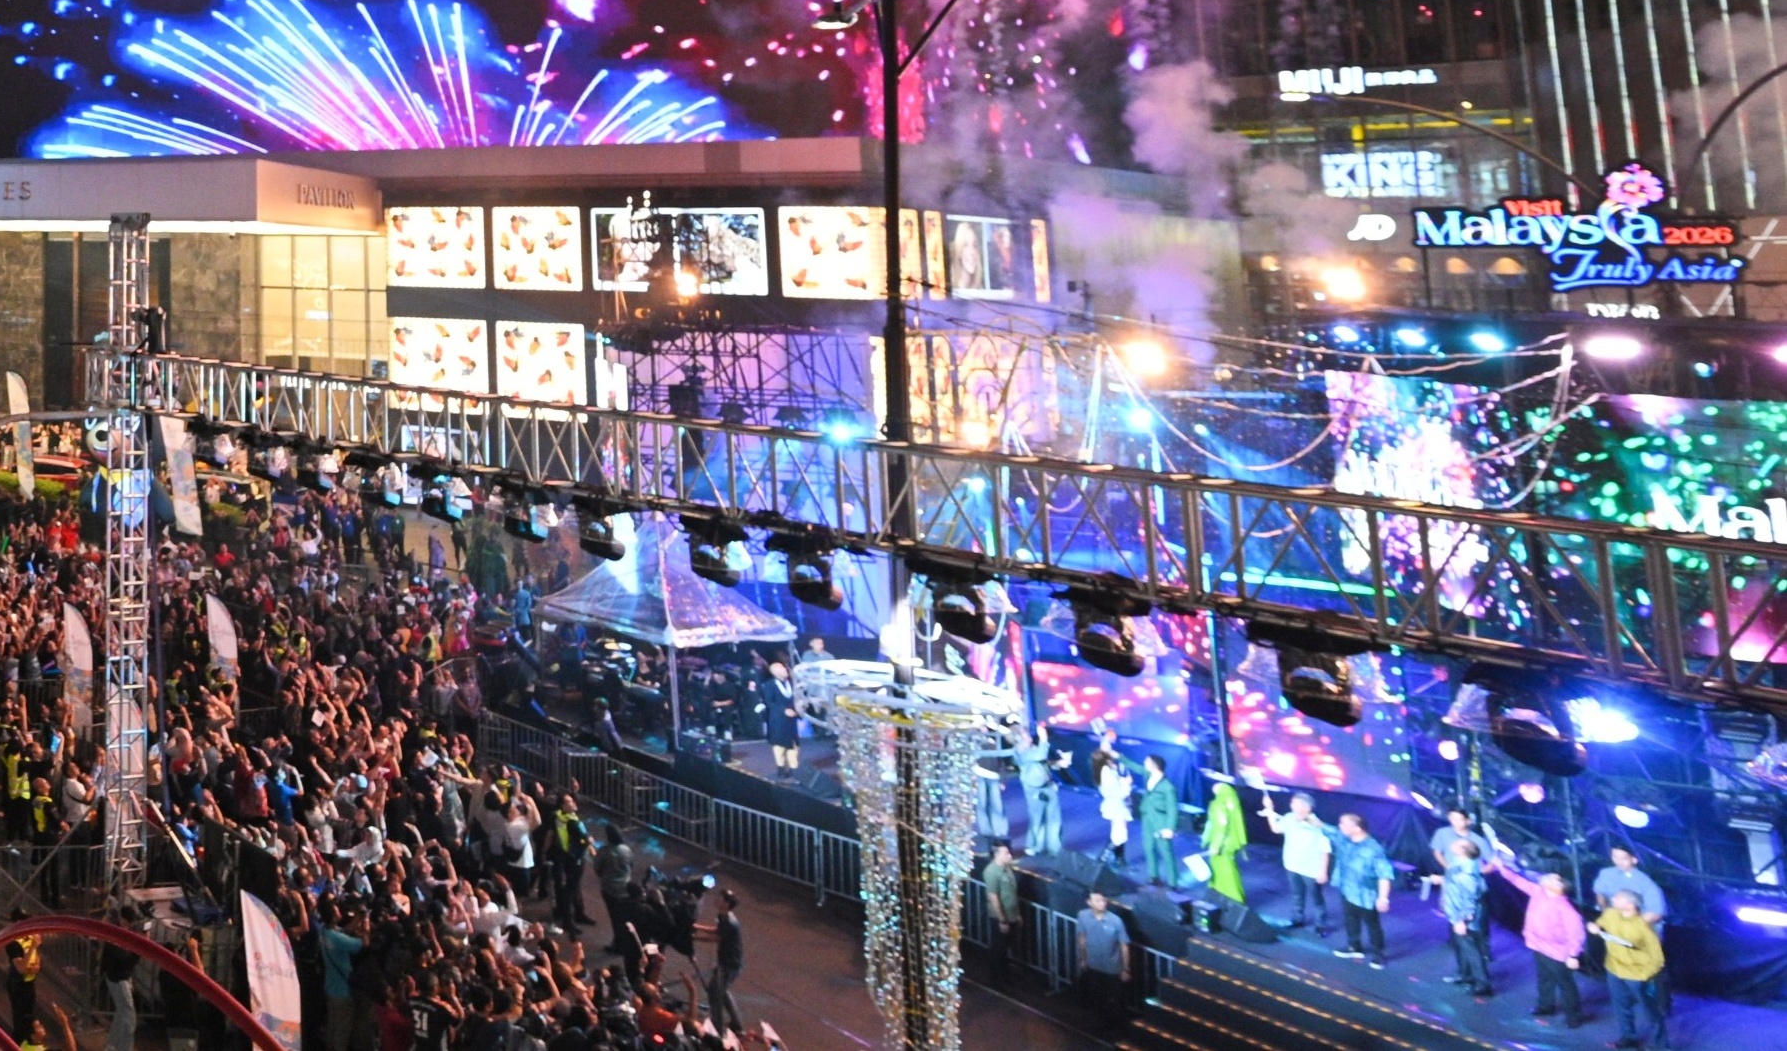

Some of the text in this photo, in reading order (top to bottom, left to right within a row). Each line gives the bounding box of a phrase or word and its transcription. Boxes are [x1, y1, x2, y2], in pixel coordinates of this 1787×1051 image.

[296, 183, 356, 211] PAVILION
[1414, 200, 1735, 254] Malaysia 2026
[1550, 249, 1737, 290] Truly Asia
